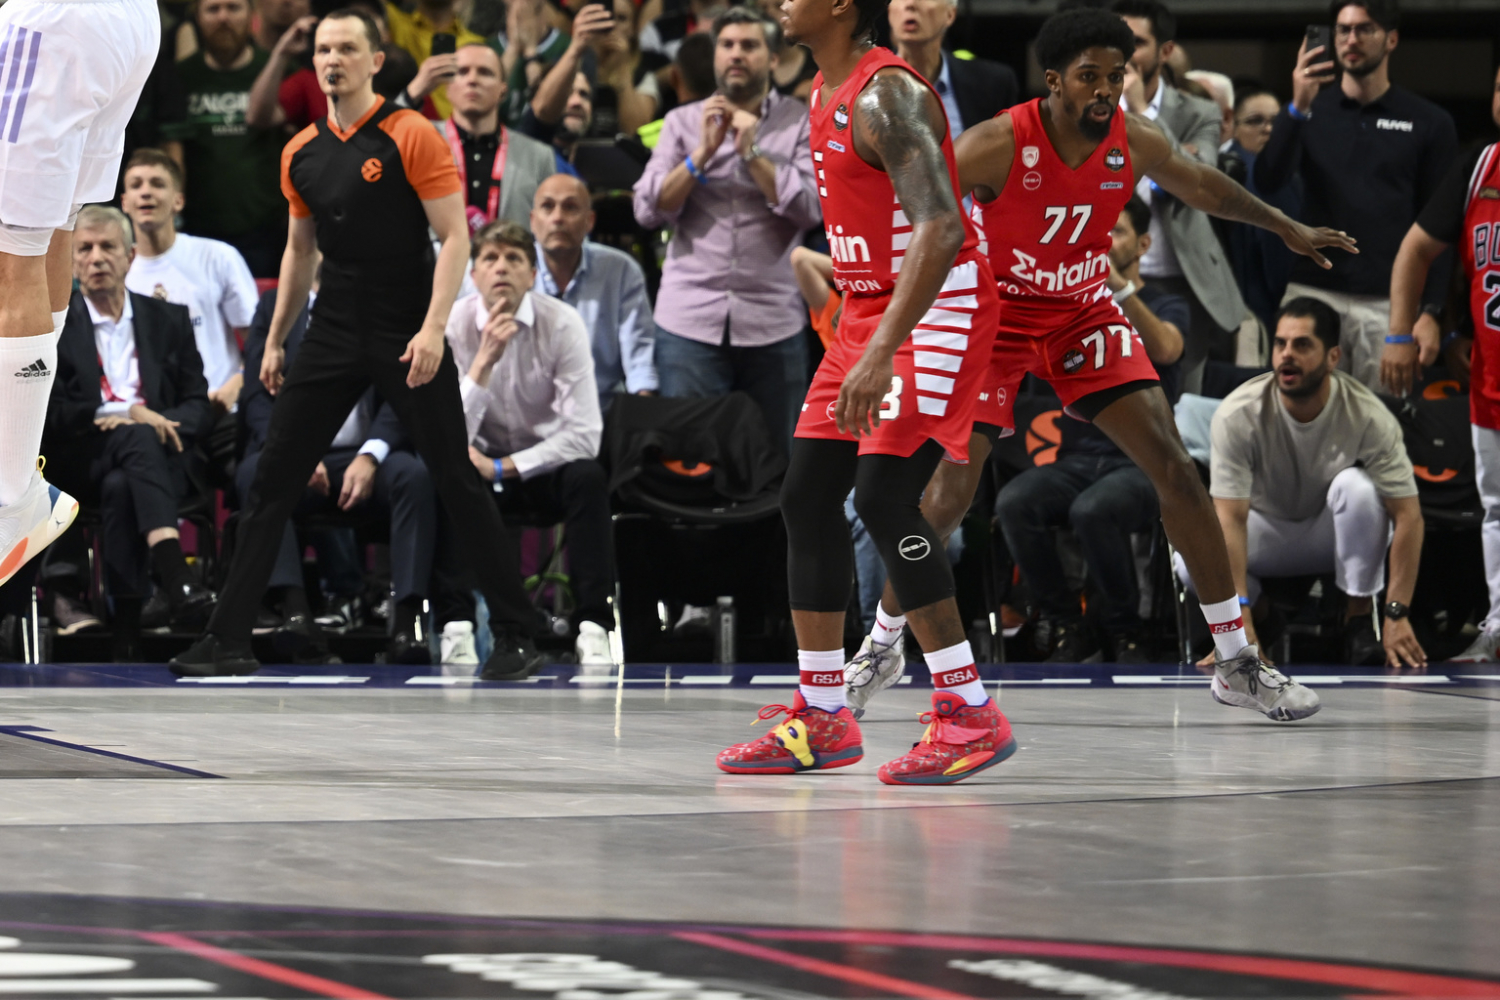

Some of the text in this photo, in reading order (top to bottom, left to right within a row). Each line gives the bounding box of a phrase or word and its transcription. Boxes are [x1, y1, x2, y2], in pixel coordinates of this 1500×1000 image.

[1038, 204, 1093, 245] 77
[1080, 324, 1132, 371] 77
[14, 369, 51, 378] adidas
[812, 673, 842, 684] GSA
[942, 669, 975, 685] GSA
